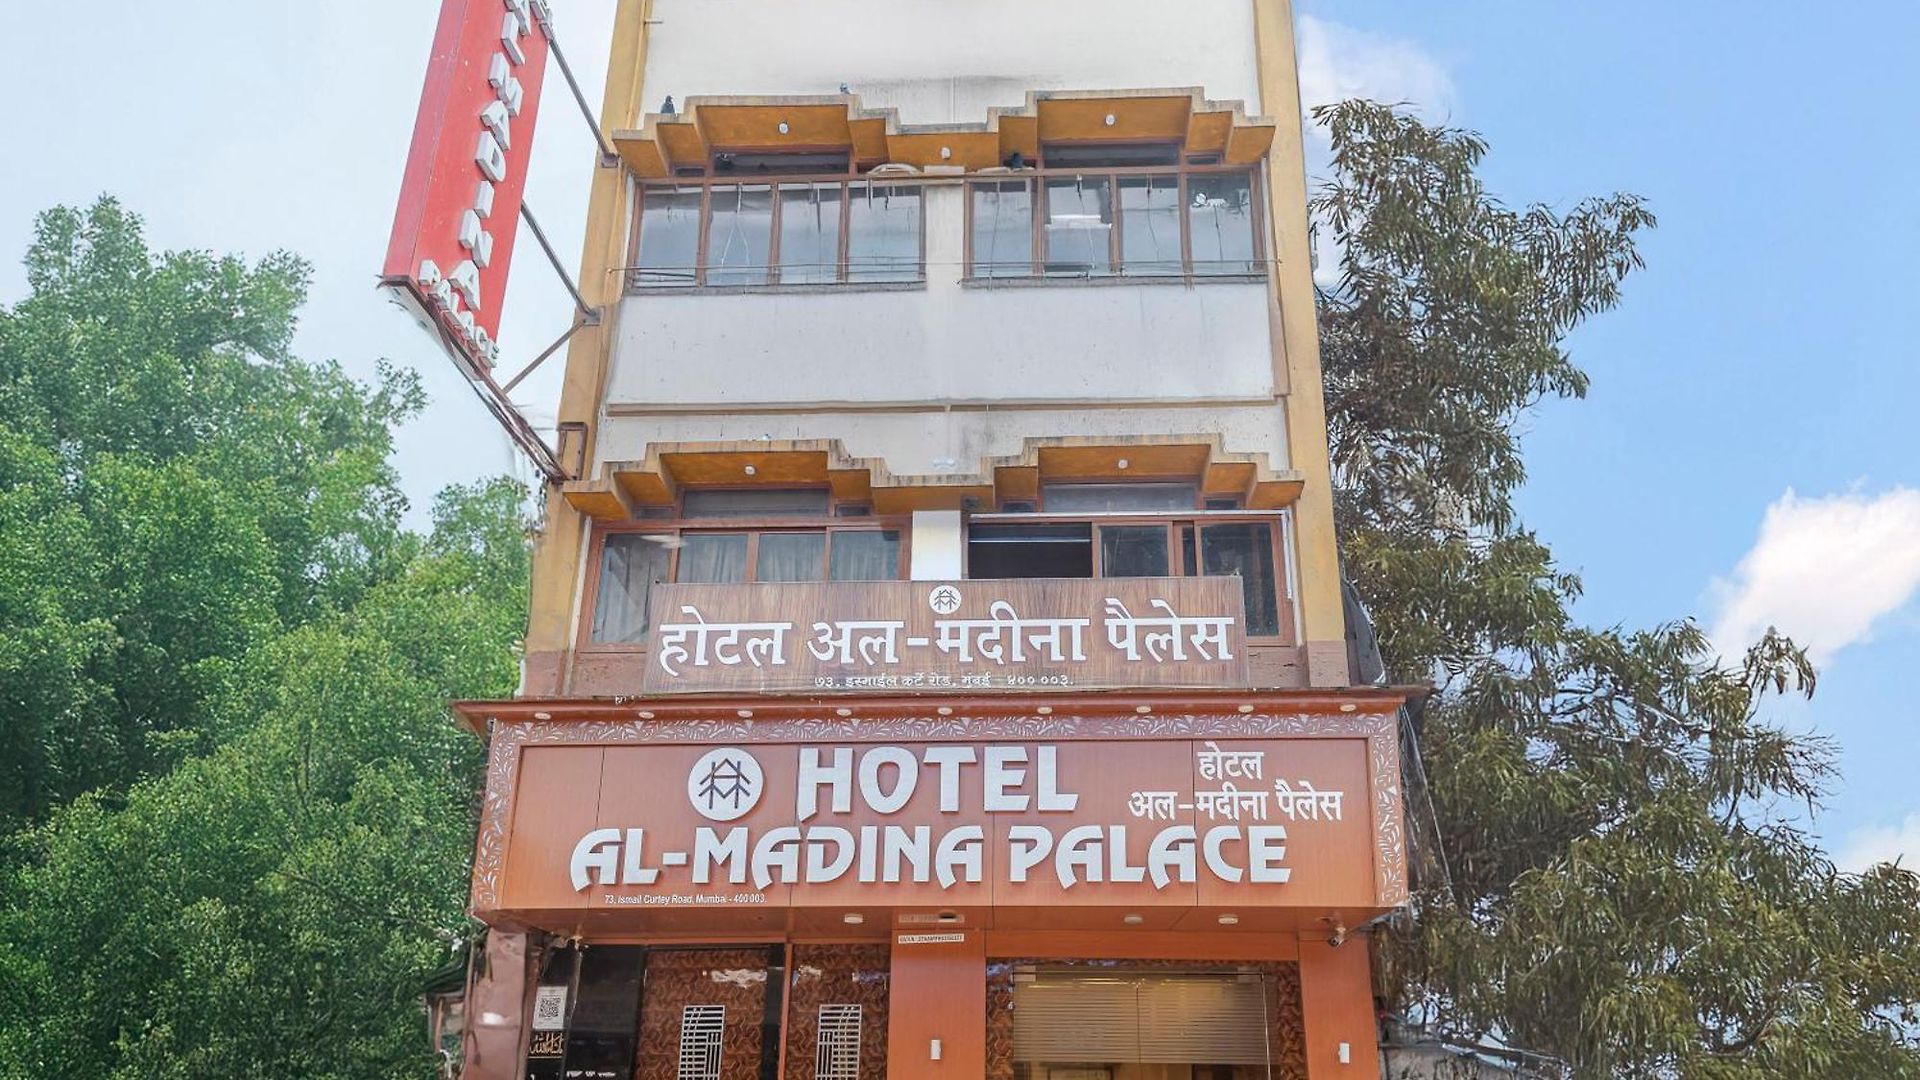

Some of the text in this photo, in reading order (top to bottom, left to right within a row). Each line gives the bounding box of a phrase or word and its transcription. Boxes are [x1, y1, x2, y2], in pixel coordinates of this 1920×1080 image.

[659, 605, 792, 676] होटल
[1104, 598, 1235, 663] पैलेस
[962, 671, 991, 688] मुंबई
[1197, 741, 1264, 780] होटल
[799, 746, 1079, 823] HOTEL
[1274, 778, 1344, 821] पैलेस
[570, 825, 1291, 892] AL-MADINA PALACE
[618, 894, 642, 904] Ismail
[695, 894, 726, 904] Mumbai
